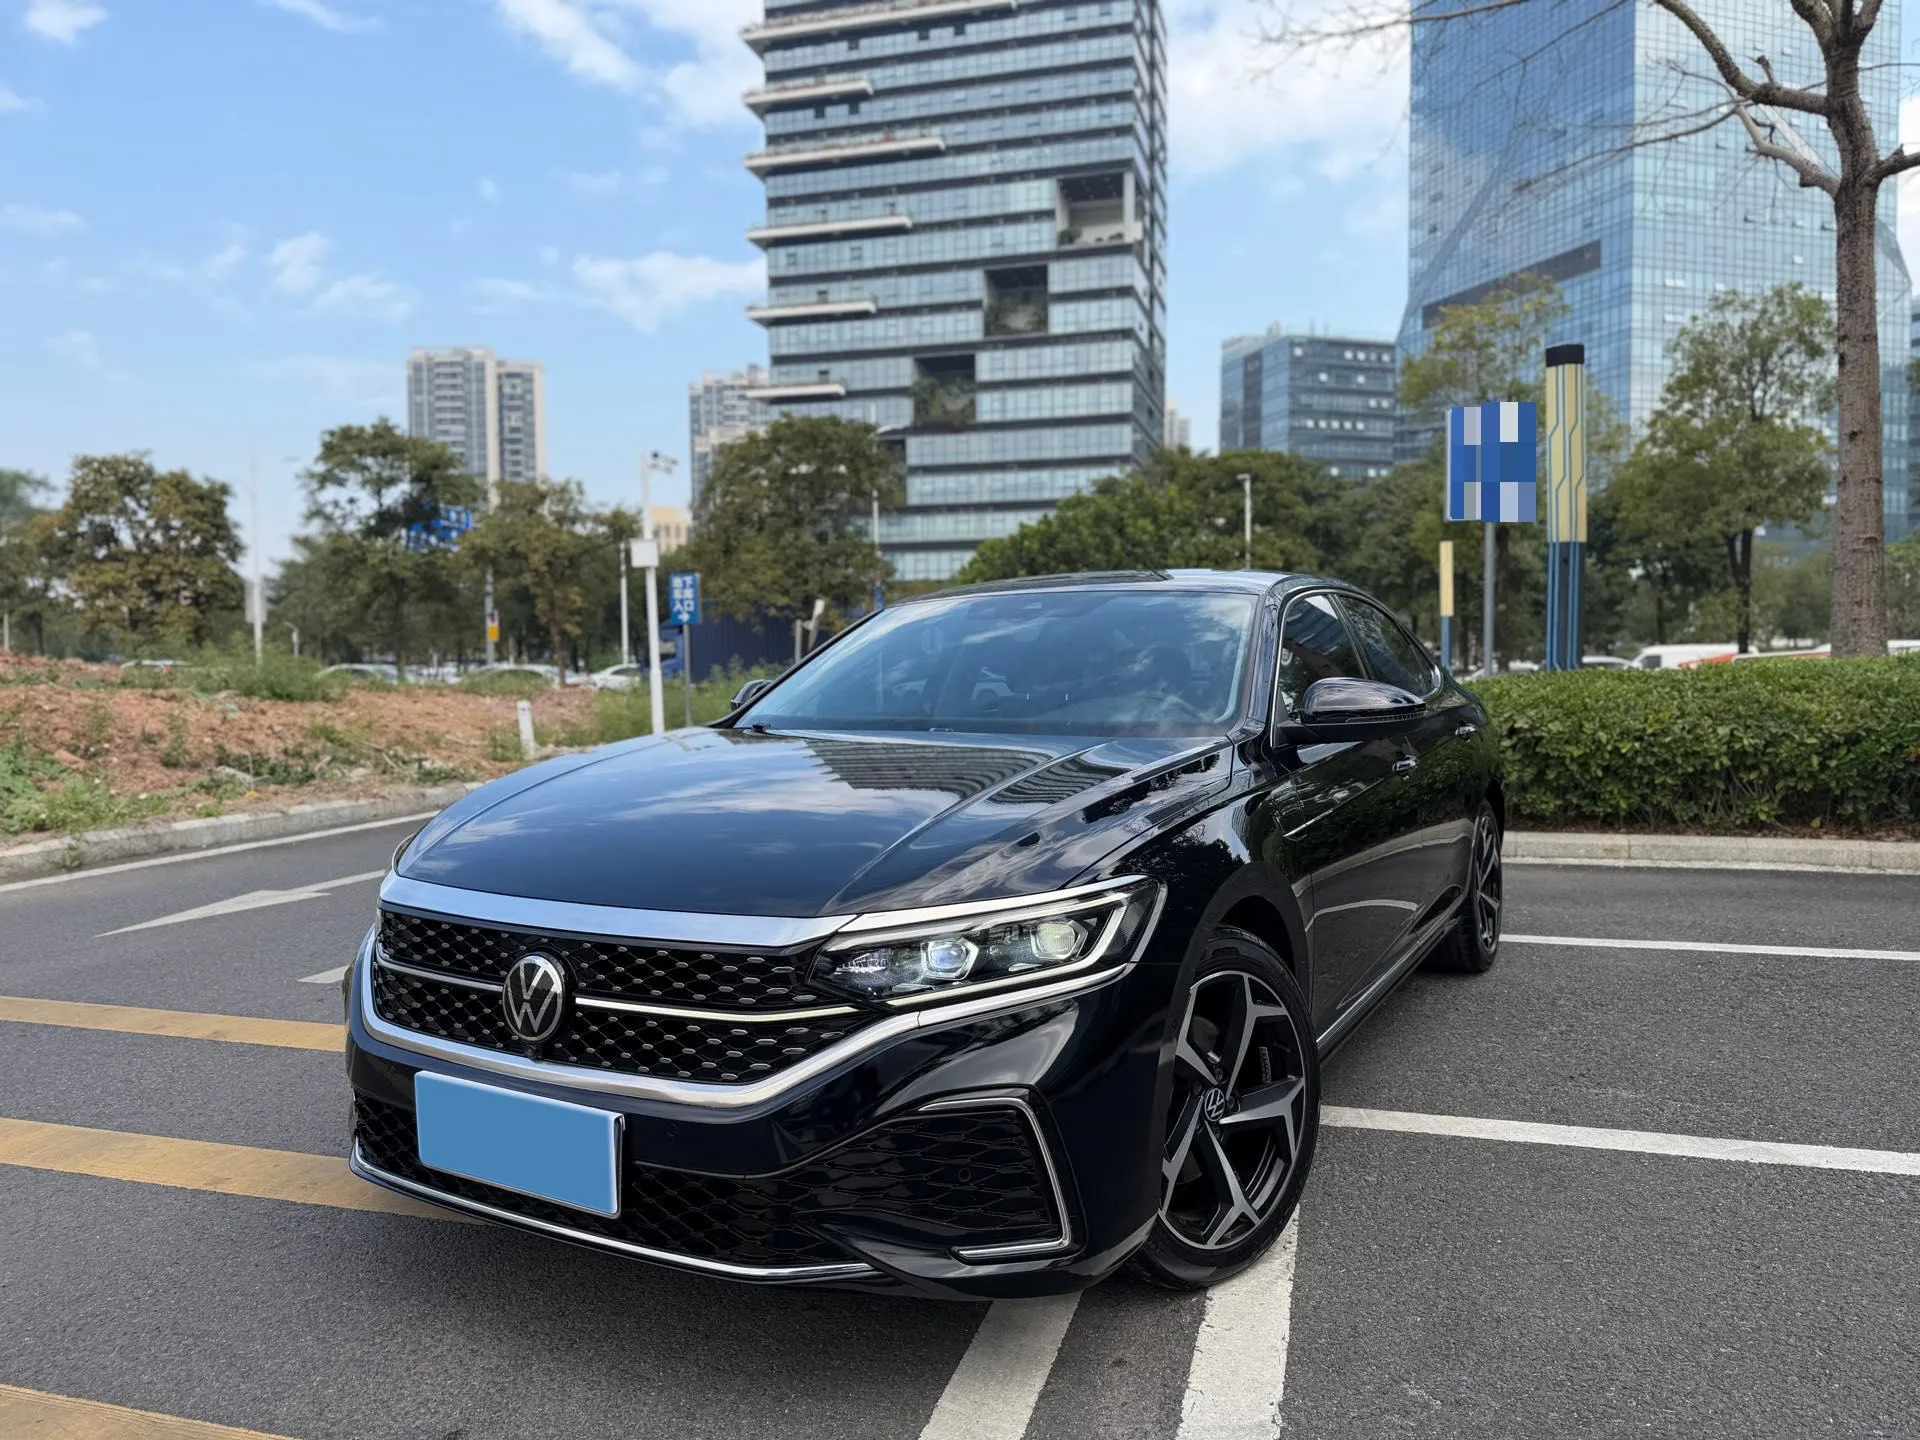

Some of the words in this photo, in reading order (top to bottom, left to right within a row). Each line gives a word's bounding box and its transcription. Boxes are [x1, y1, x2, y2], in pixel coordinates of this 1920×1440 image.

[673, 600, 695, 612] 入口
[505, 958, 560, 1037] VW
[1206, 1089, 1225, 1119] VW
